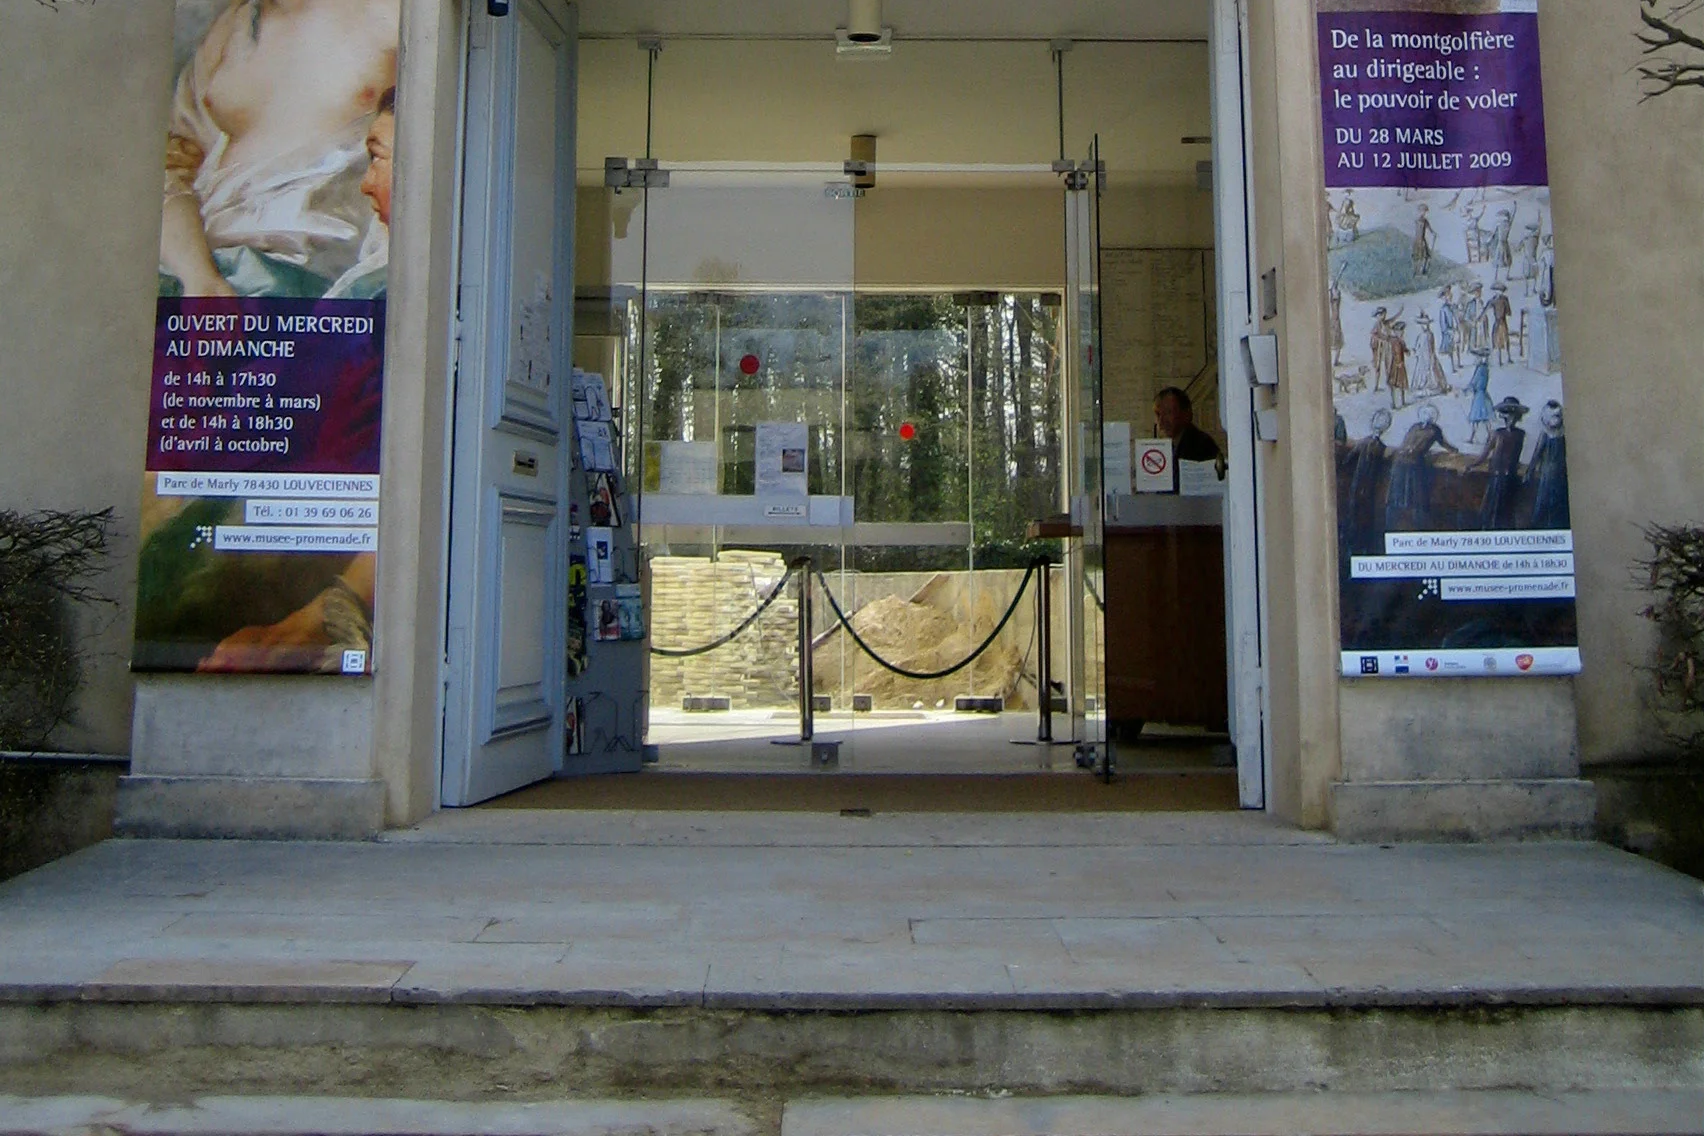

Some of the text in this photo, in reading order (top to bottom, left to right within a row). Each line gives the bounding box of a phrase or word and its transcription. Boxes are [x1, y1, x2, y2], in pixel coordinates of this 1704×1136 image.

[1331, 29, 1515, 55] De la montgolfière
[1333, 63, 1357, 78] au
[1366, 59, 1465, 83] dirigeable
[1333, 89, 1518, 113] le pouvoir de voler
[1335, 128, 1444, 145] DU 28 MARS
[1337, 151, 1512, 170] AU 12 JUILLET 2009
[167, 315, 373, 334] OUVERT DU MERCREDI
[165, 340, 295, 357] AU DIMANCHE
[164, 371, 277, 386] de 14h à 17h30
[163, 392, 321, 411] (de novembre à mars)
[161, 415, 294, 431] et de 14h à 18h30
[160, 436, 290, 453] (d'avril à octobre)
[164, 477, 373, 493] Parc de Marly 78430 LOUVECIENNES
[285, 507, 299, 517] 01
[304, 507, 318, 518] 39
[321, 507, 336, 518] 69
[340, 507, 354, 518] 06
[358, 507, 372, 518] 26
[1392, 535, 1566, 549] Parc de Marly 78430 LOUVECIENNES
[1358, 563, 1373, 572] DU
[1375, 562, 1428, 572] MERCREDI
[1430, 561, 1445, 570] AU
[1447, 560, 1500, 570] DIMANCHE
[1502, 559, 1513, 569] de
